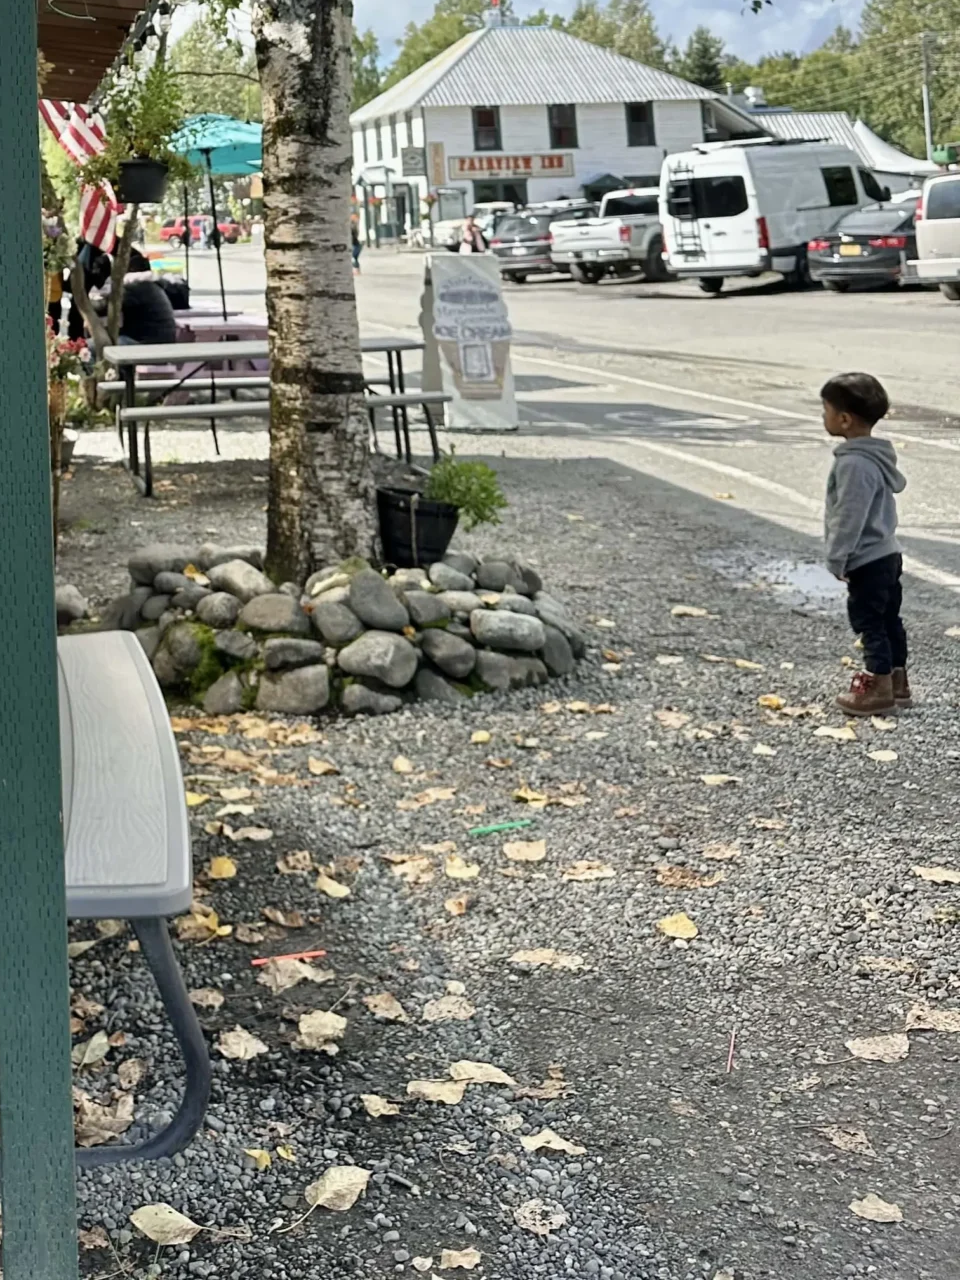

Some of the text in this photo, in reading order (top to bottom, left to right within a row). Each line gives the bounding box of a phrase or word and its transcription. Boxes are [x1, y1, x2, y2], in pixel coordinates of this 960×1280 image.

[458, 155, 564, 171] FAIRVIEW INN
[435, 324, 513, 341] ICE CREAM
